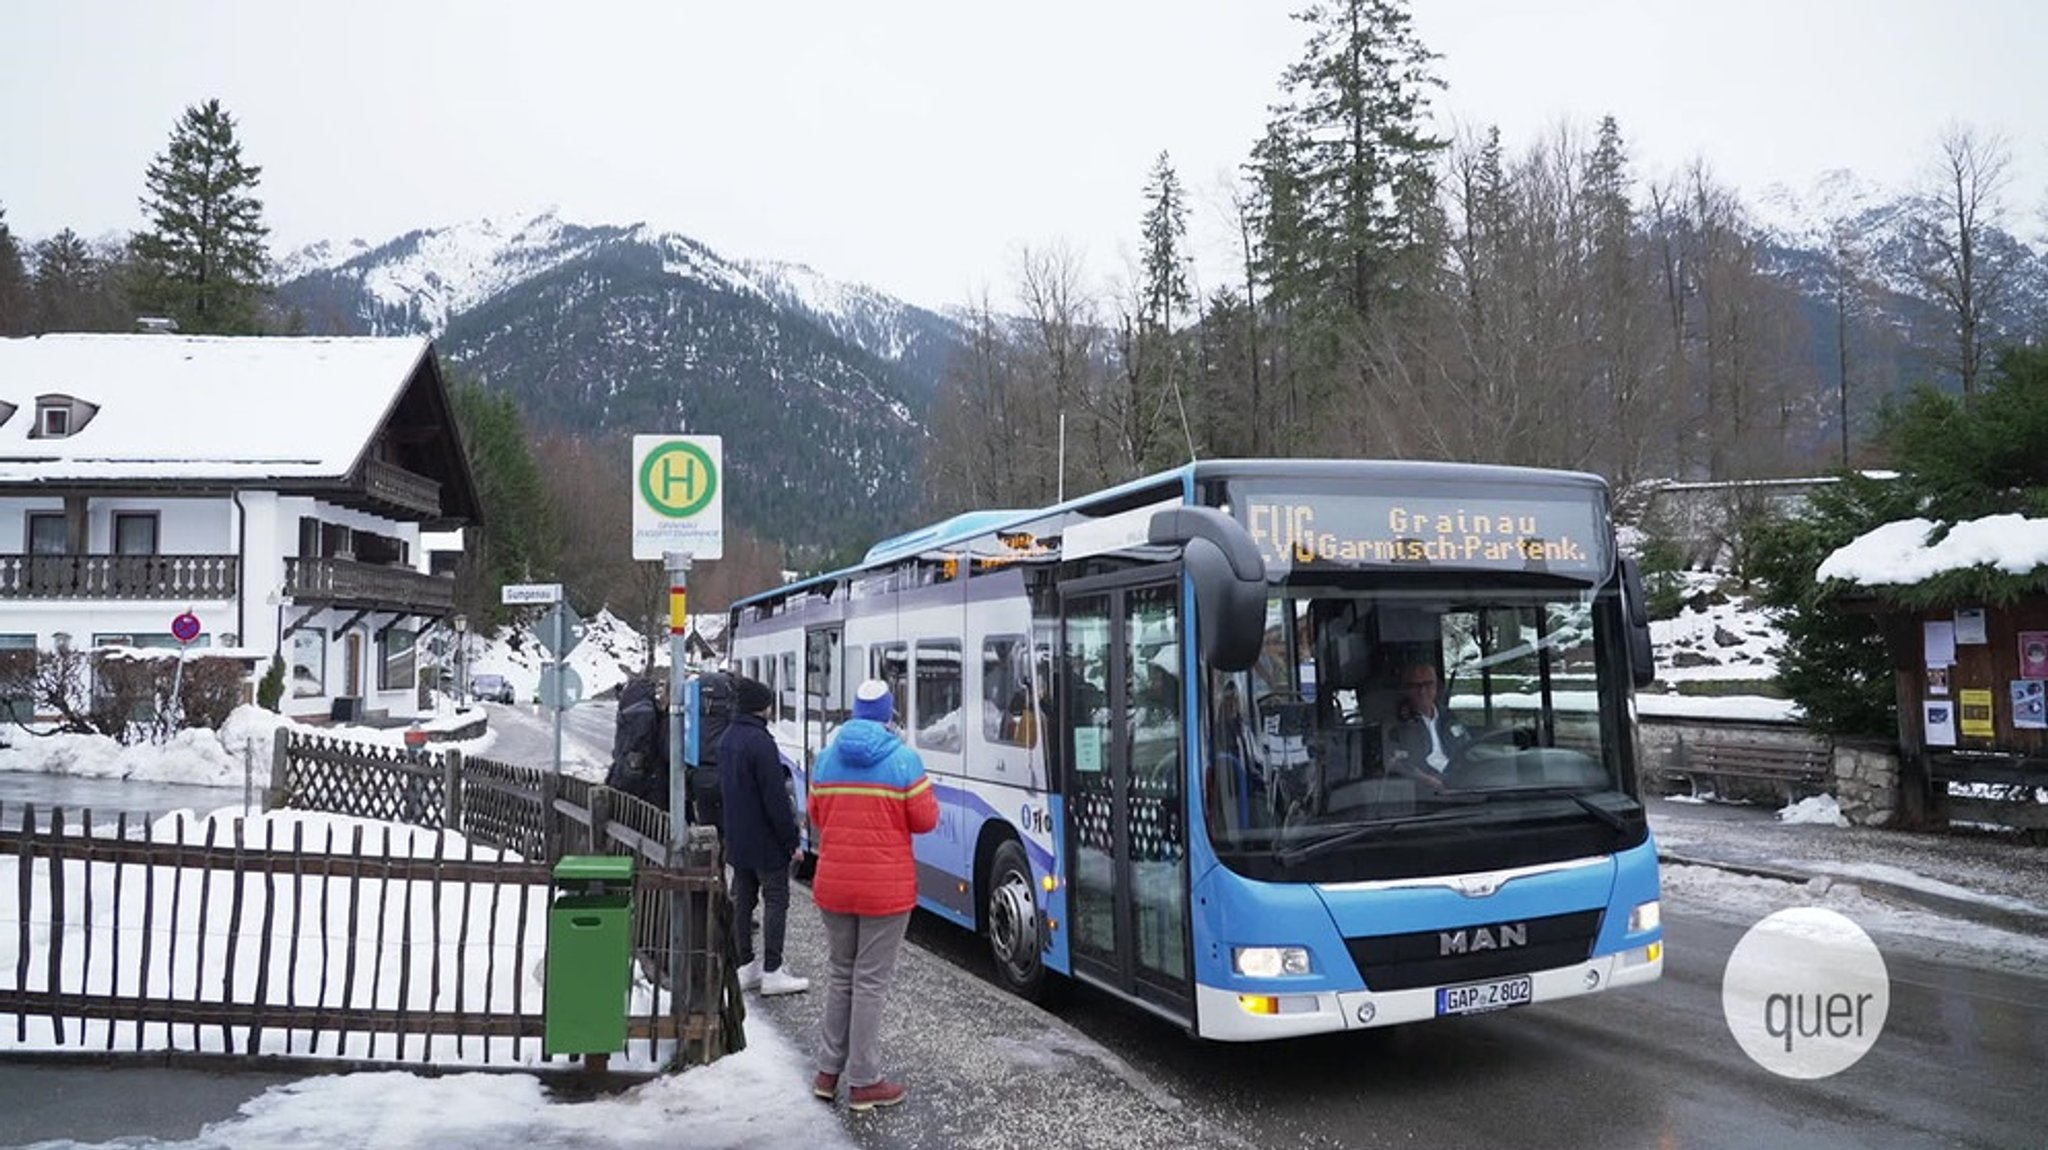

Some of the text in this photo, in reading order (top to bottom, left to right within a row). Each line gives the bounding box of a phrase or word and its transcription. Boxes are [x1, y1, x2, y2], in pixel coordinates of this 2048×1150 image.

[663, 458, 694, 500] H
[1388, 507, 1537, 534] Grainau
[1318, 533, 1587, 561] Garmisch-Partenk.
[1439, 923, 1527, 955] MAN
[1448, 981, 1528, 1009] GAP Z 802
